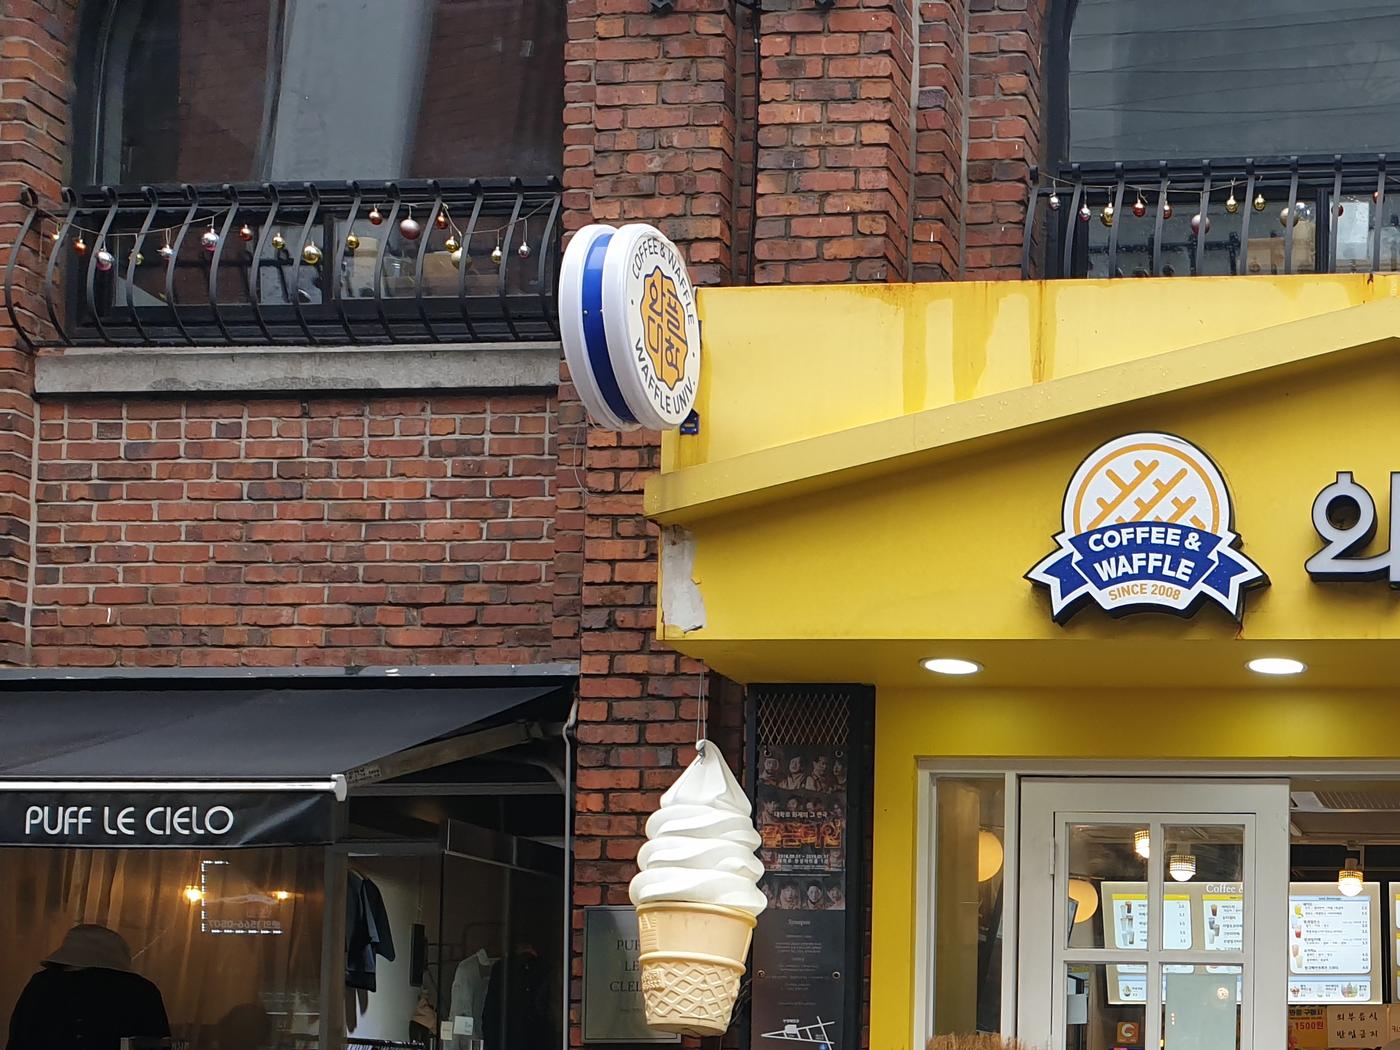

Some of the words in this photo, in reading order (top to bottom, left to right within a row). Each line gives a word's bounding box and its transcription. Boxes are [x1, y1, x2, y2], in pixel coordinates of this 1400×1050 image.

[632, 238, 658, 279] COFFEE
[658, 241, 666, 258] &
[667, 250, 695, 325] WAFFLE
[635, 337, 671, 414] WAFFLE
[674, 381, 696, 414] UNIV.
[1088, 526, 1181, 552] COFFEE
[1184, 532, 1202, 551] &
[1093, 553, 1195, 582] WAFFLE
[1108, 583, 1147, 601] SINCE
[1150, 584, 1181, 600] 2008
[25, 806, 92, 835] PUFF
[104, 806, 134, 835] LE
[146, 806, 234, 835] CIELO
[1206, 884, 1236, 893] Coffee
